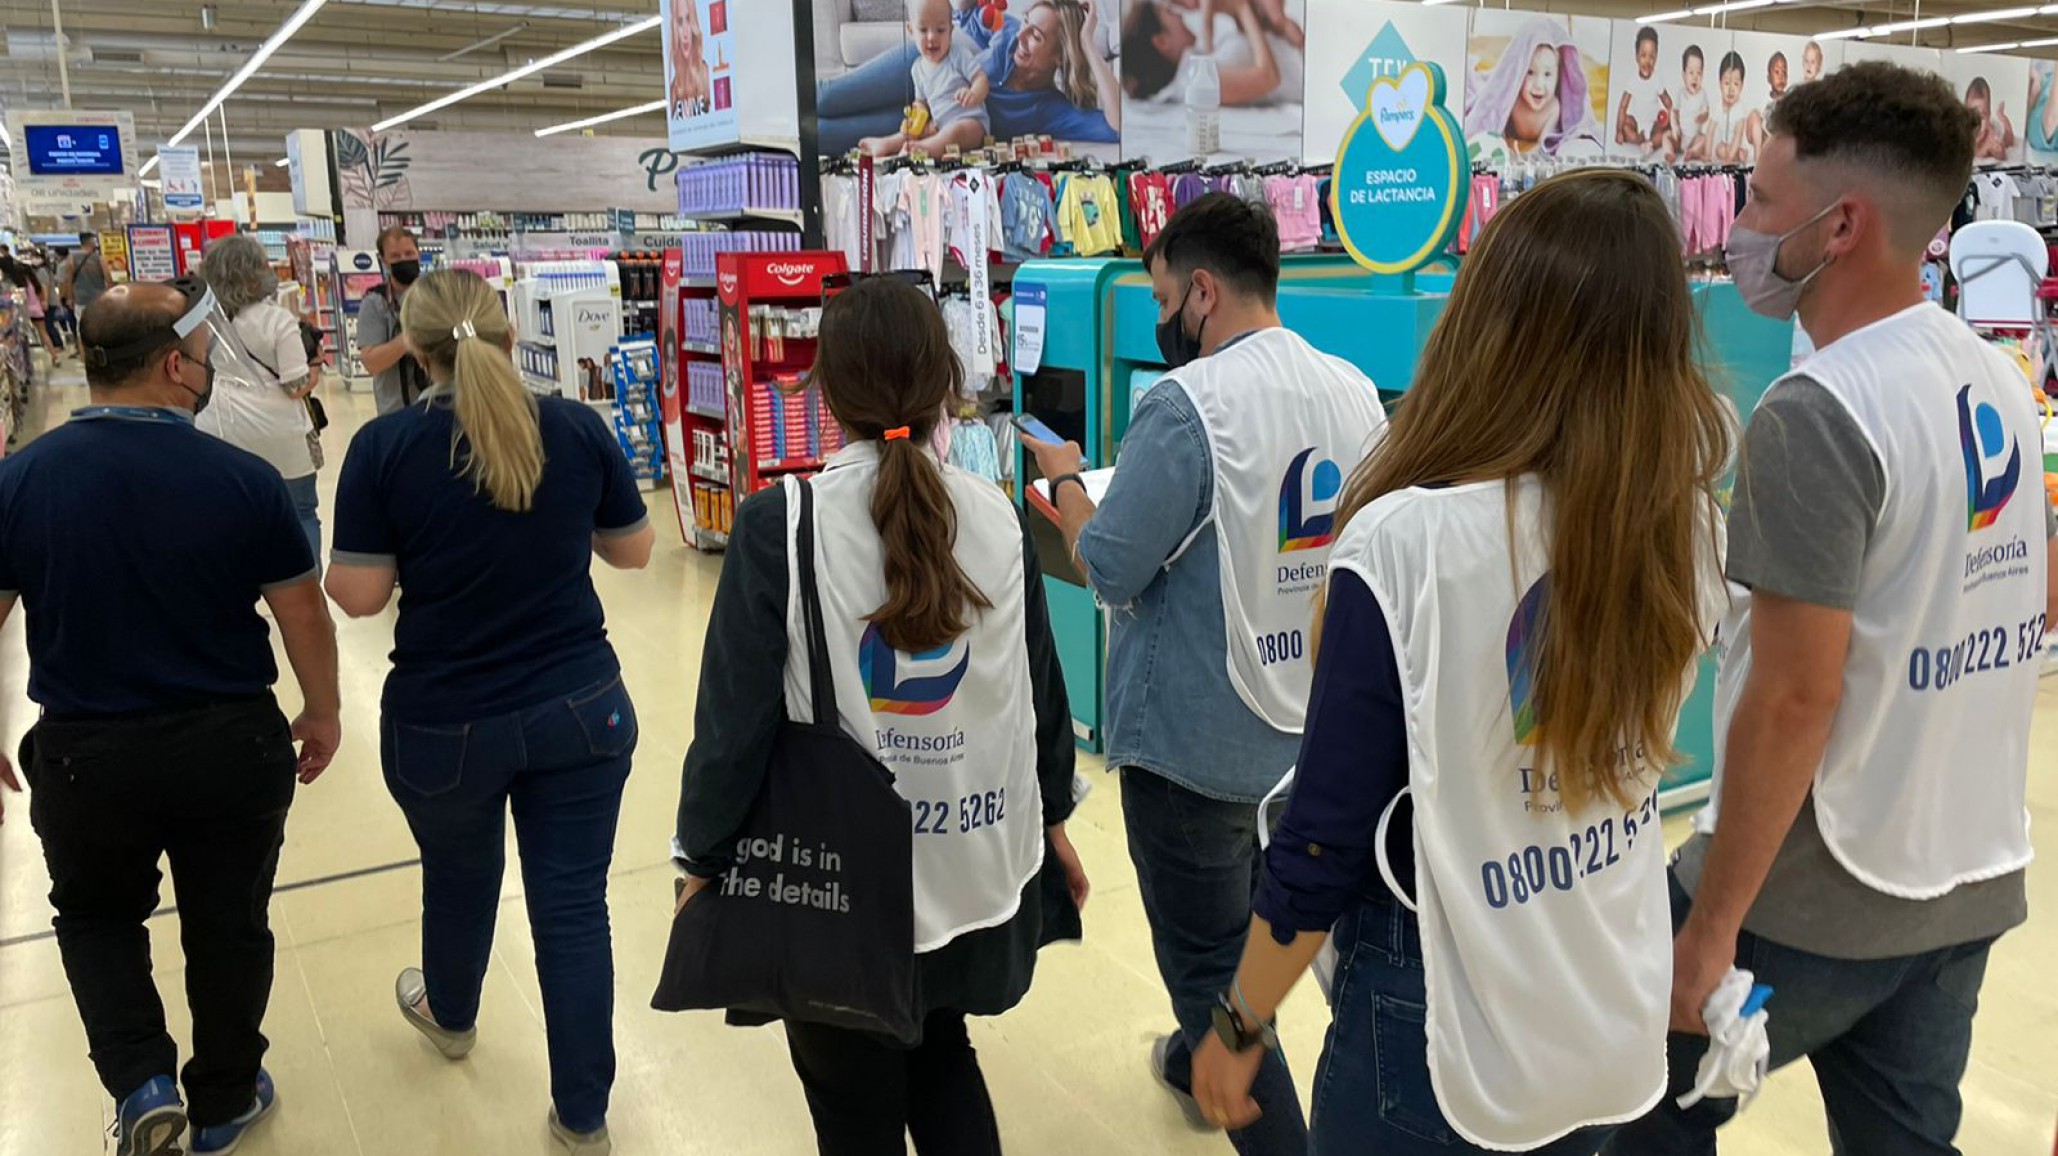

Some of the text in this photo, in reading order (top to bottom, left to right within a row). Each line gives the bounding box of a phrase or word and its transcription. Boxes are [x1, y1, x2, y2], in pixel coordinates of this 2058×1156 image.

[1380, 107, 1416, 124] Pampers
[1350, 187, 1436, 203] DE LACTANCIA
[1366, 168, 1417, 184] ESPACIO
[766, 262, 815, 277] Colgate
[973, 224, 987, 354] Desde 6 a 36 meses
[578, 309, 611, 323] Dove
[1257, 628, 1303, 667] 0800
[960, 787, 1005, 834] 5262
[736, 833, 842, 872] god is in
[768, 873, 851, 914] details
[1481, 844, 1574, 909] 0800
